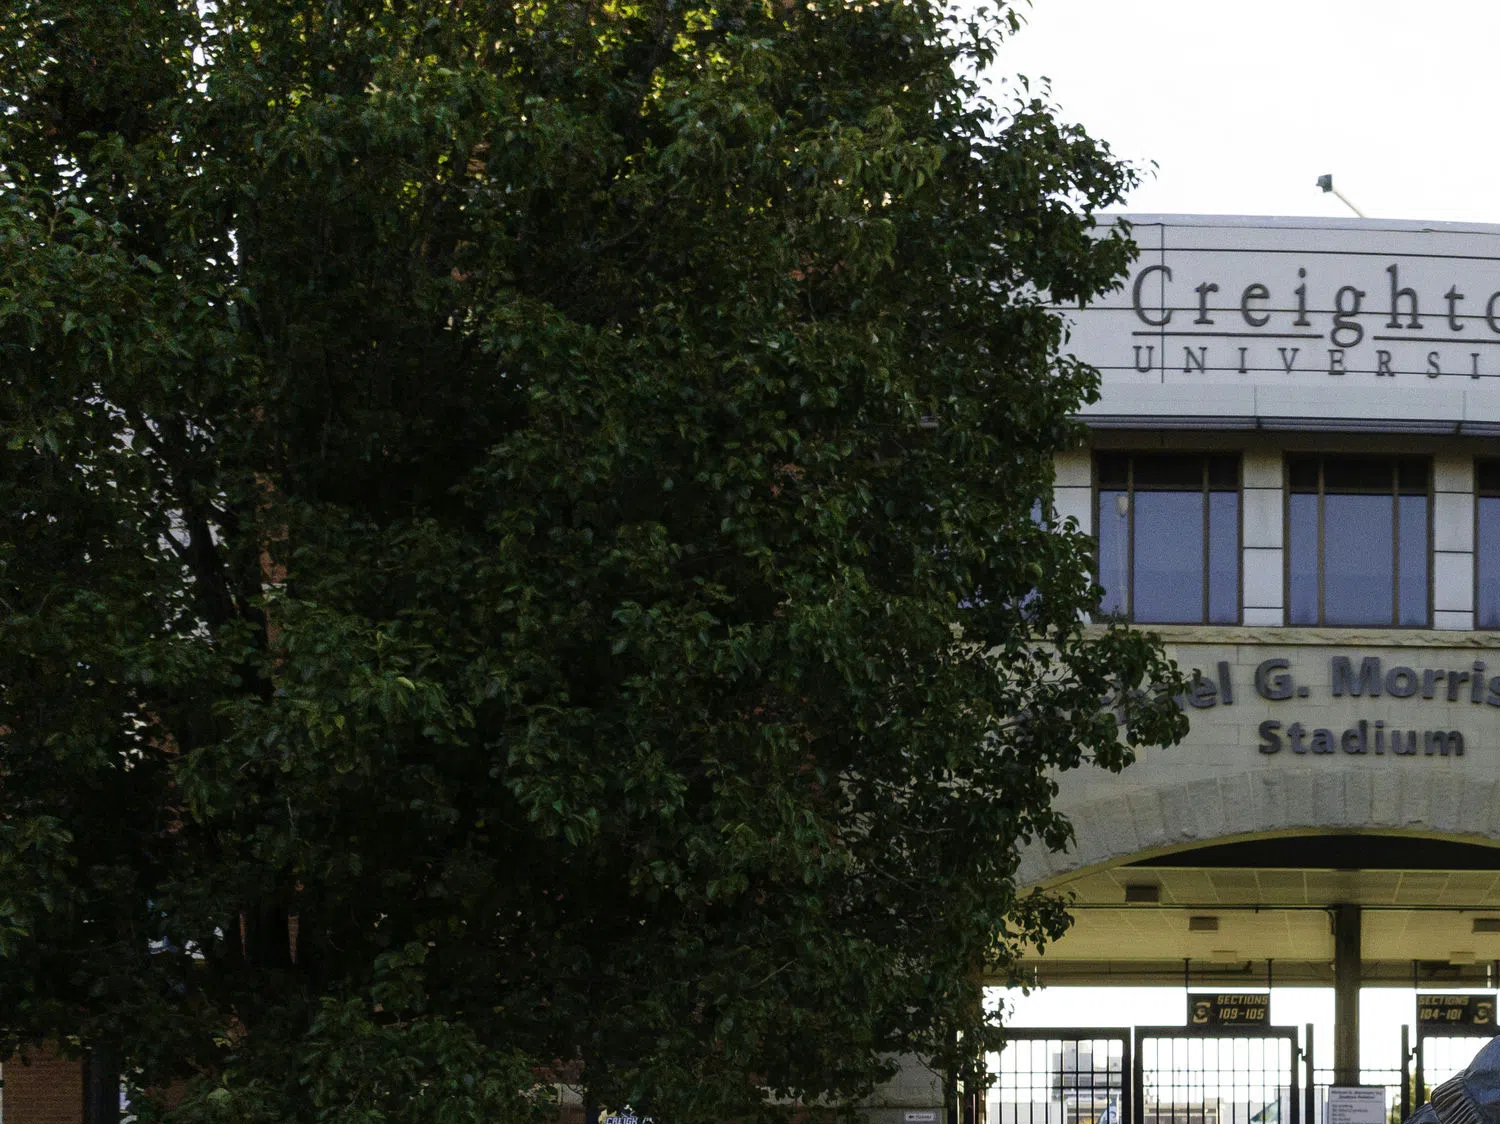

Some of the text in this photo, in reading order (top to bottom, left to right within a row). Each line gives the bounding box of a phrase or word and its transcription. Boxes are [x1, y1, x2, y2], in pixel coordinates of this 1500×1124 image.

[1254, 658, 1309, 701] G.
[1258, 719, 1465, 756] Stadium
[1217, 995, 1268, 1005] SECTIONS
[1418, 996, 1469, 1005] SECTIONS
